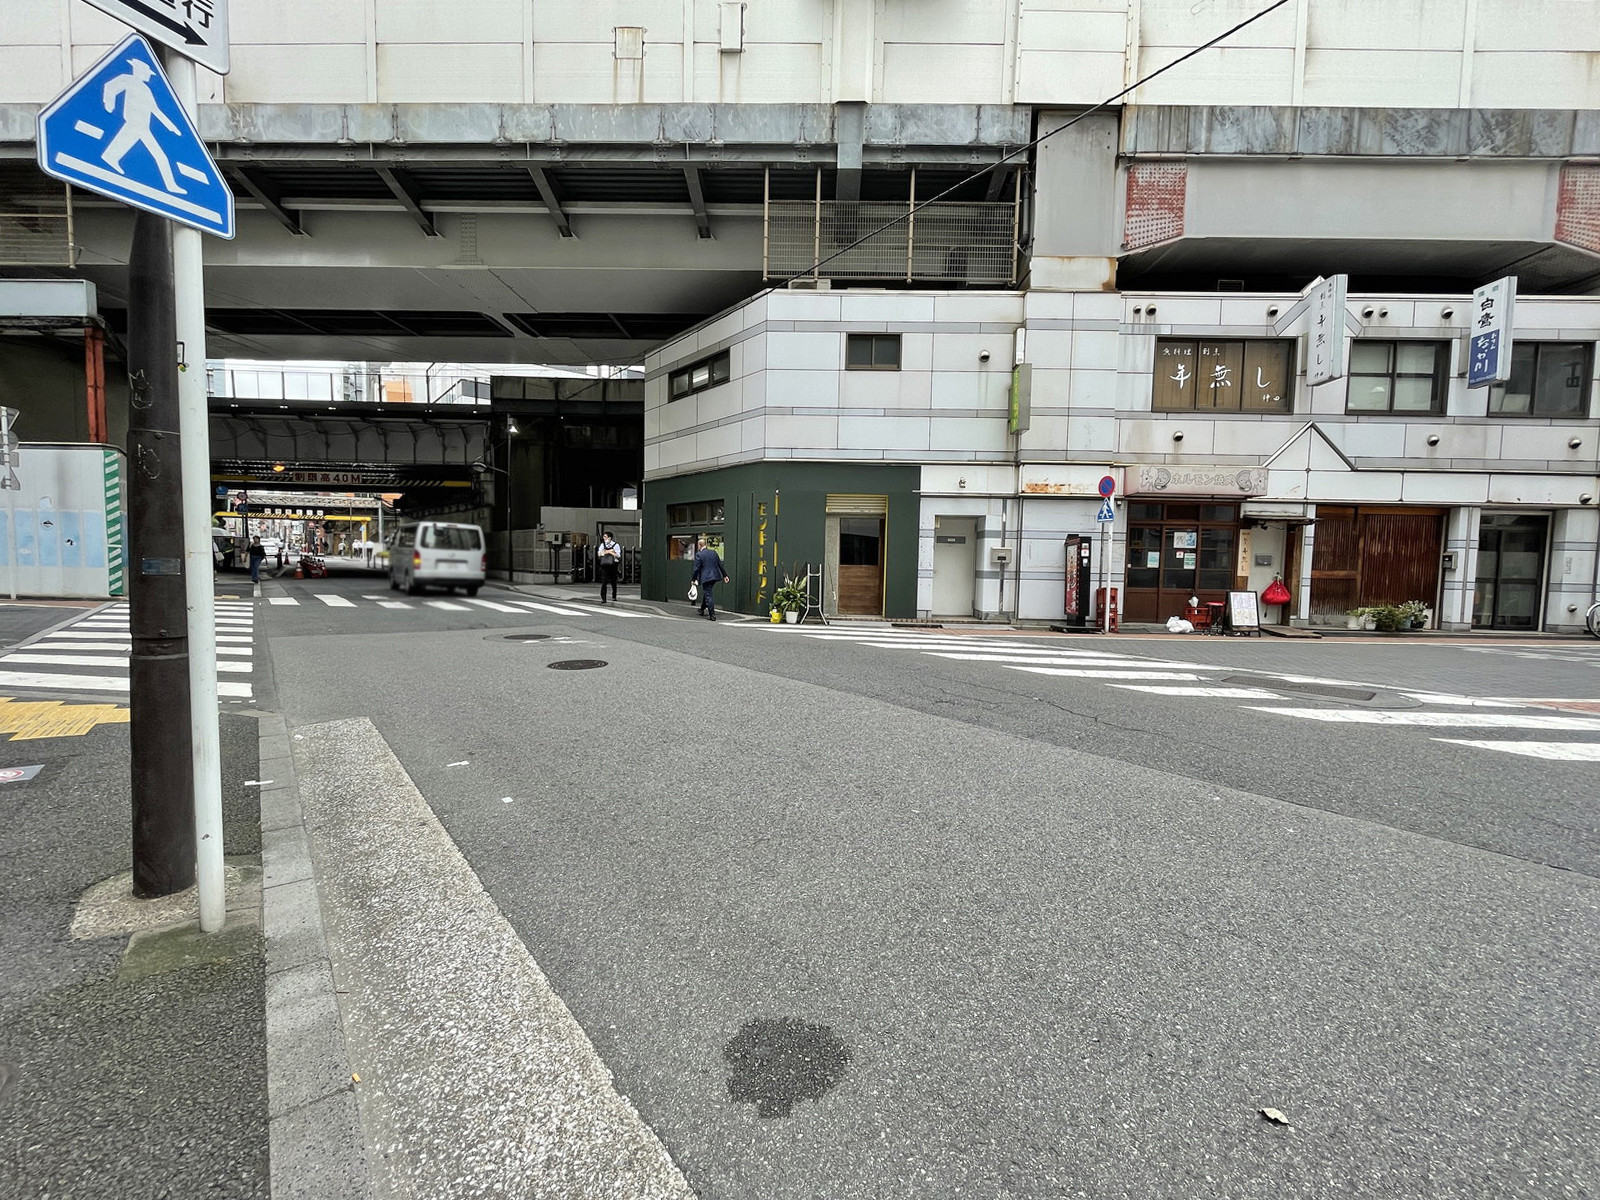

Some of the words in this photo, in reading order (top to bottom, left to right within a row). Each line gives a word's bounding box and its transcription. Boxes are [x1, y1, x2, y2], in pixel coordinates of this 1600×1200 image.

[1169, 363, 1271, 389] 年無し
[1171, 472, 1236, 487] ホルモン焼肉
